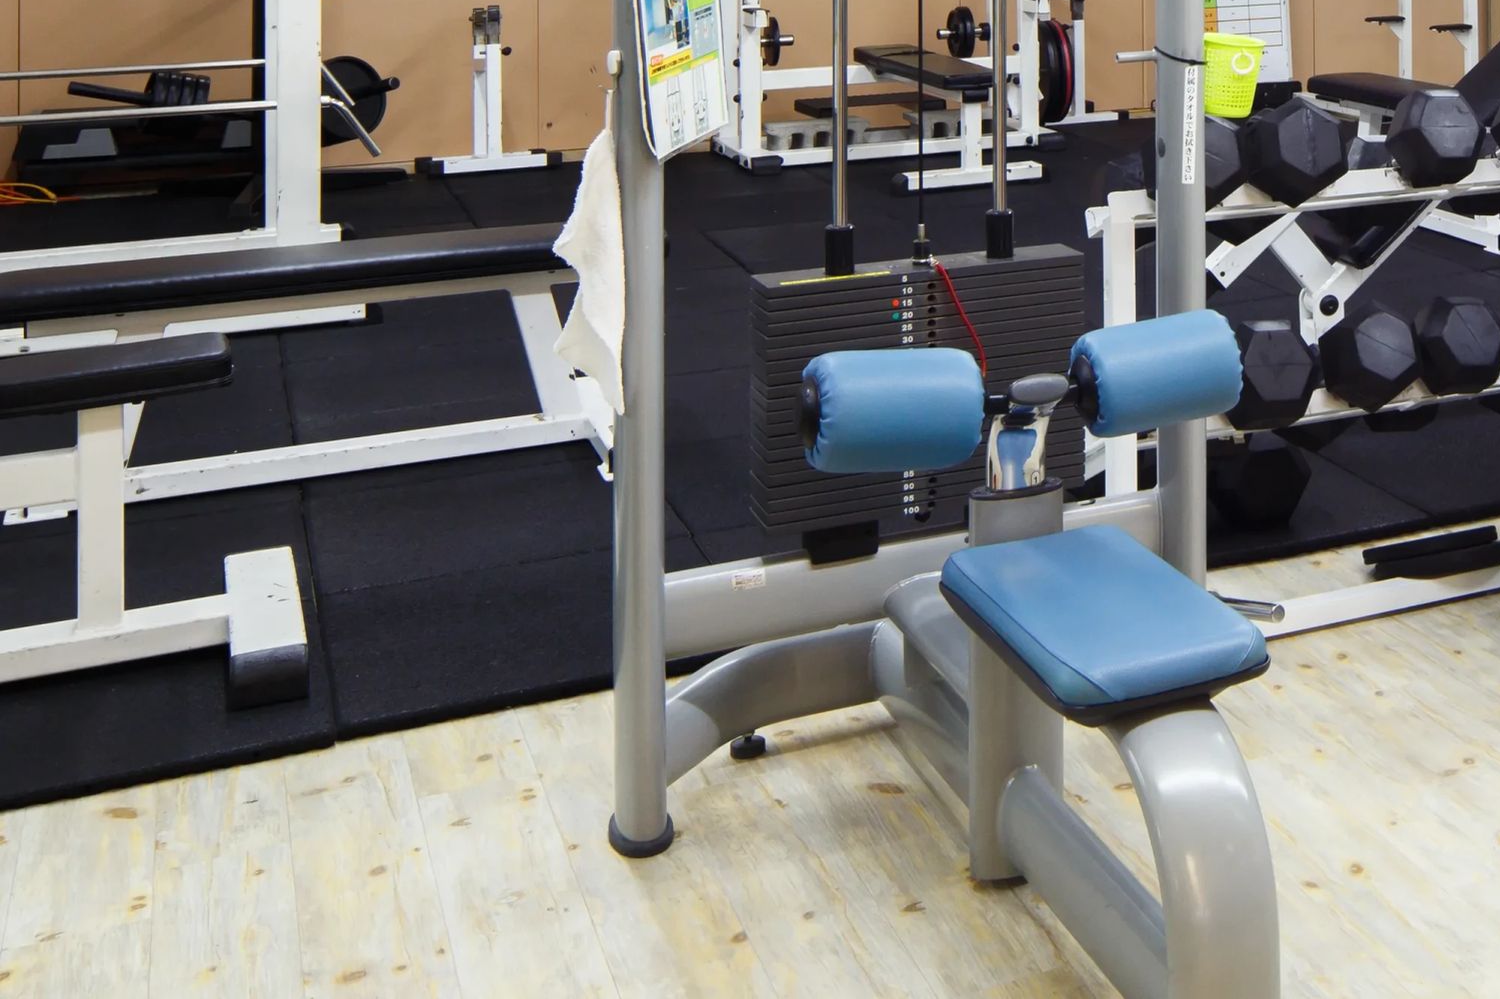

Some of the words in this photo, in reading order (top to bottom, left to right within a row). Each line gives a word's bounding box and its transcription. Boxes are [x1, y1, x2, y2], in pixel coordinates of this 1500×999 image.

[902, 287, 913, 295] 10
[902, 299, 913, 307] 15
[902, 311, 913, 319] 20
[902, 323, 913, 332] 25
[902, 336, 913, 344] 30
[904, 482, 914, 490] 90
[904, 494, 914, 503] 95
[904, 506, 920, 515] 100
